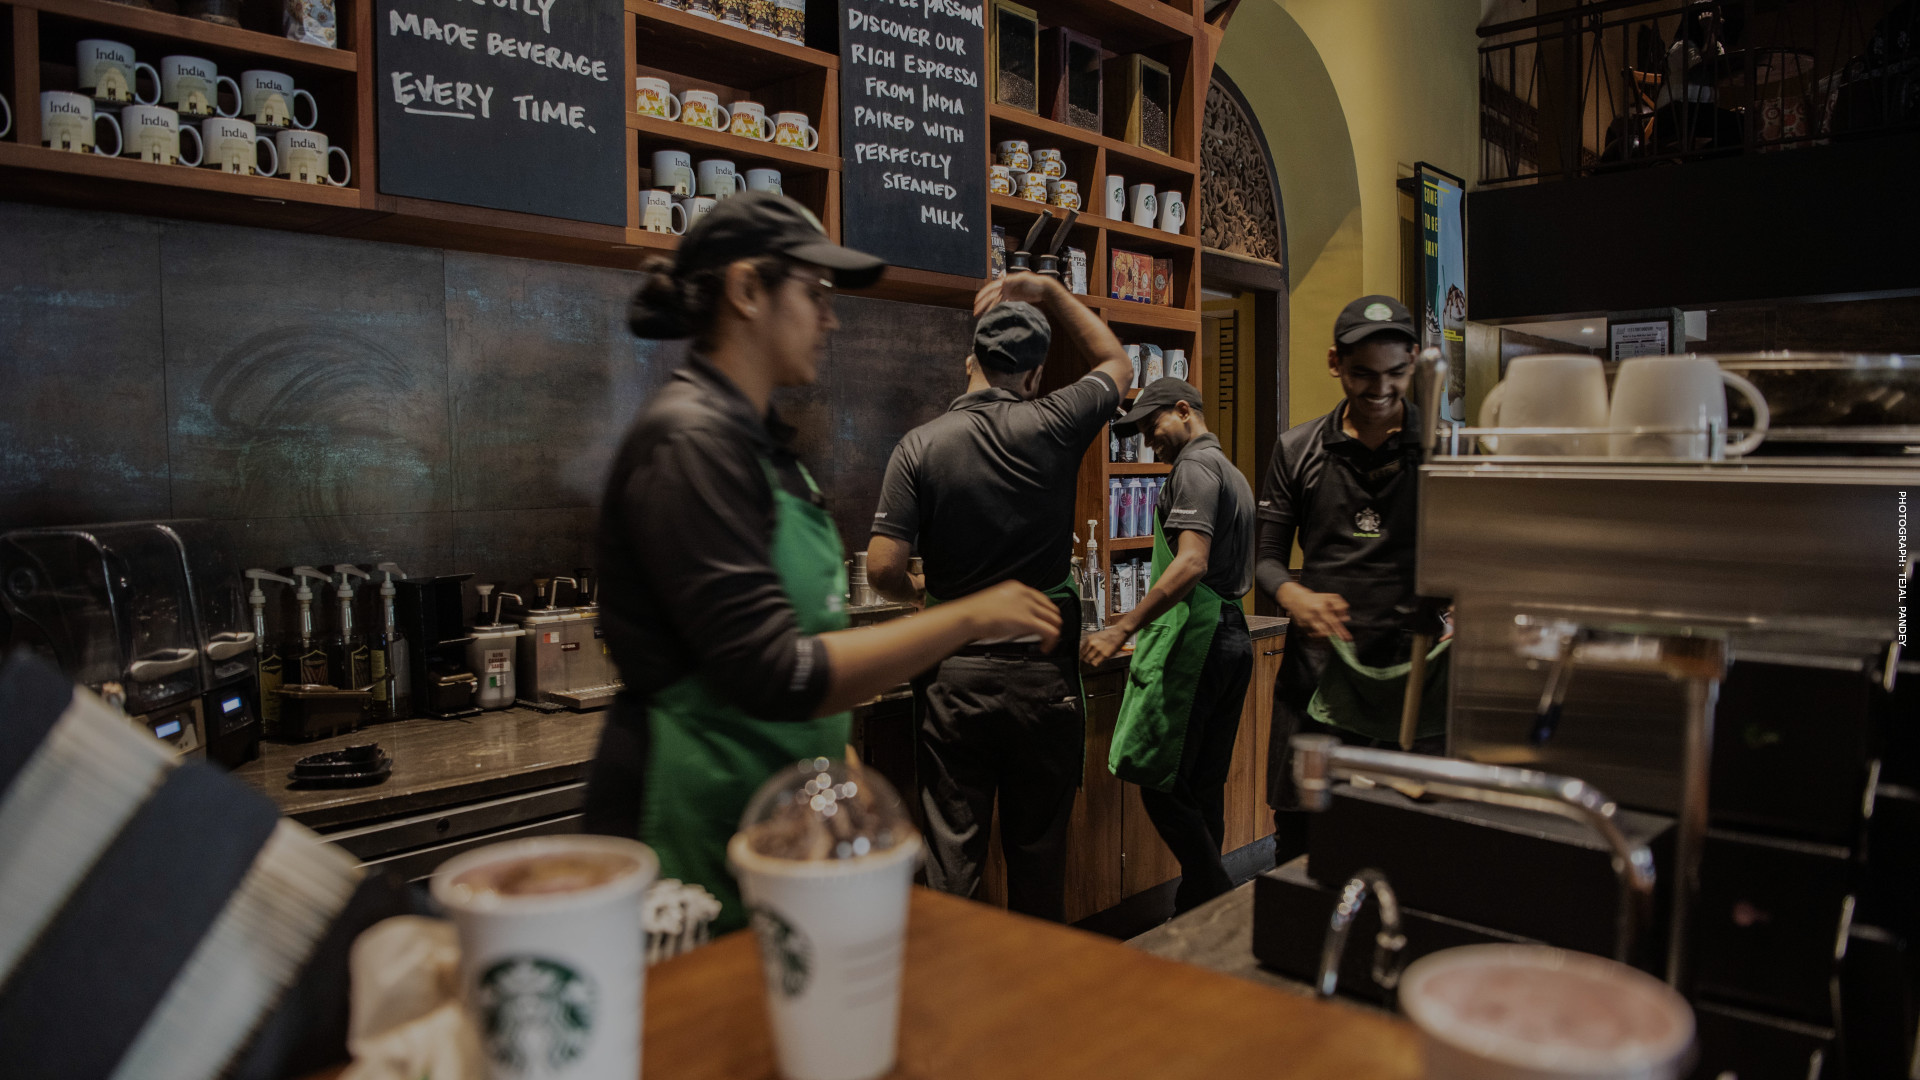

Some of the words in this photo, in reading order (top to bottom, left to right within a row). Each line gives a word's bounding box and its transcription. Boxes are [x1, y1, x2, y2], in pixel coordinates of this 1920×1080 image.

[848, 8, 931, 48] DISCOVER
[935, 32, 967, 56] OUR
[389, 9, 479, 50] MADE
[486, 32, 609, 82] BEVERAGE
[95, 47, 125, 63] India
[177, 64, 206, 79] India
[850, 43, 896, 69] RICH
[904, 54, 978, 88] ESPRESSO
[255, 77, 283, 91] India
[391, 71, 494, 120] EVERY
[512, 94, 597, 134] TIME.
[865, 76, 915, 105] FROM
[922, 83, 965, 115] INDIA
[50, 100, 81, 115] India
[141, 113, 169, 128] India
[853, 105, 915, 133] PAIRED
[922, 121, 964, 144] WITH
[221, 126, 248, 140] India
[290, 137, 316, 150] India
[854, 142, 952, 181] PERFECTLY
[715, 166, 733, 176] India
[882, 171, 957, 200] STEAMED
[647, 196, 667, 207] India
[698, 203, 713, 214] Indi
[920, 204, 970, 233] MILK.
